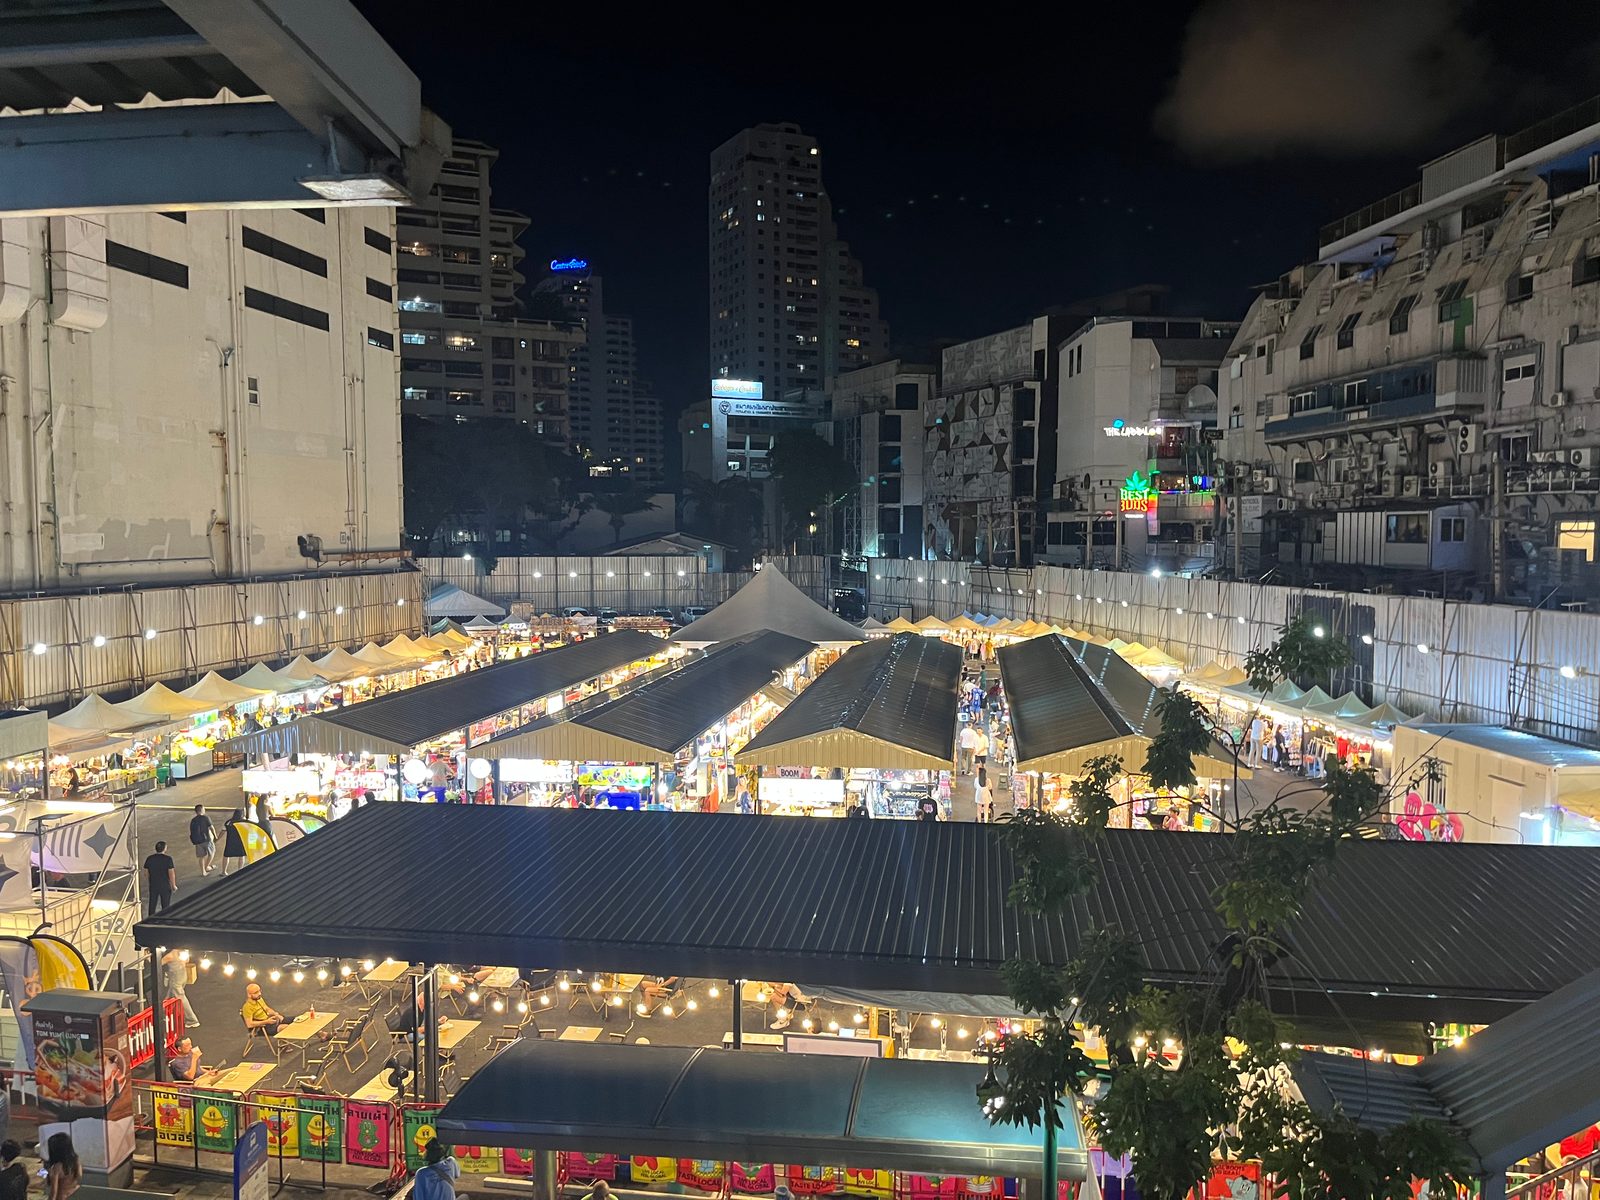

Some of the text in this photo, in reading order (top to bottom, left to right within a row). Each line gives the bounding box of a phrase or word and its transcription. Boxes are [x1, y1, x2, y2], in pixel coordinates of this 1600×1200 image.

[1120, 488, 1150, 501] BEST
[780, 768, 799, 777] BOOM
[790, 1181, 811, 1189] TASTE
